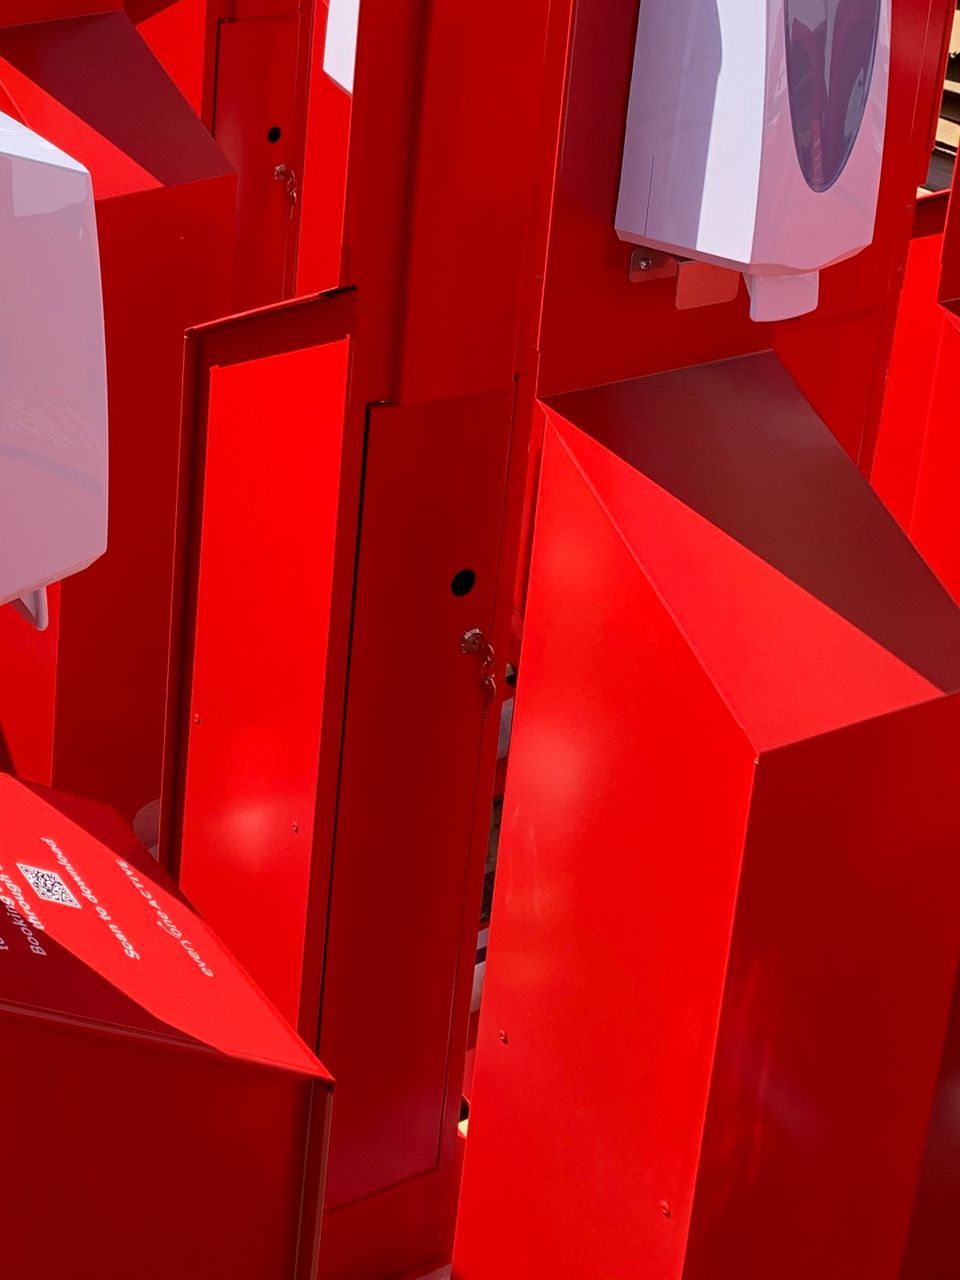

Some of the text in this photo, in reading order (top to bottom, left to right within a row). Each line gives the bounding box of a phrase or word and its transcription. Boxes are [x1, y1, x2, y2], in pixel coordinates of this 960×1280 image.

[40, 837, 141, 960] Scan to download
